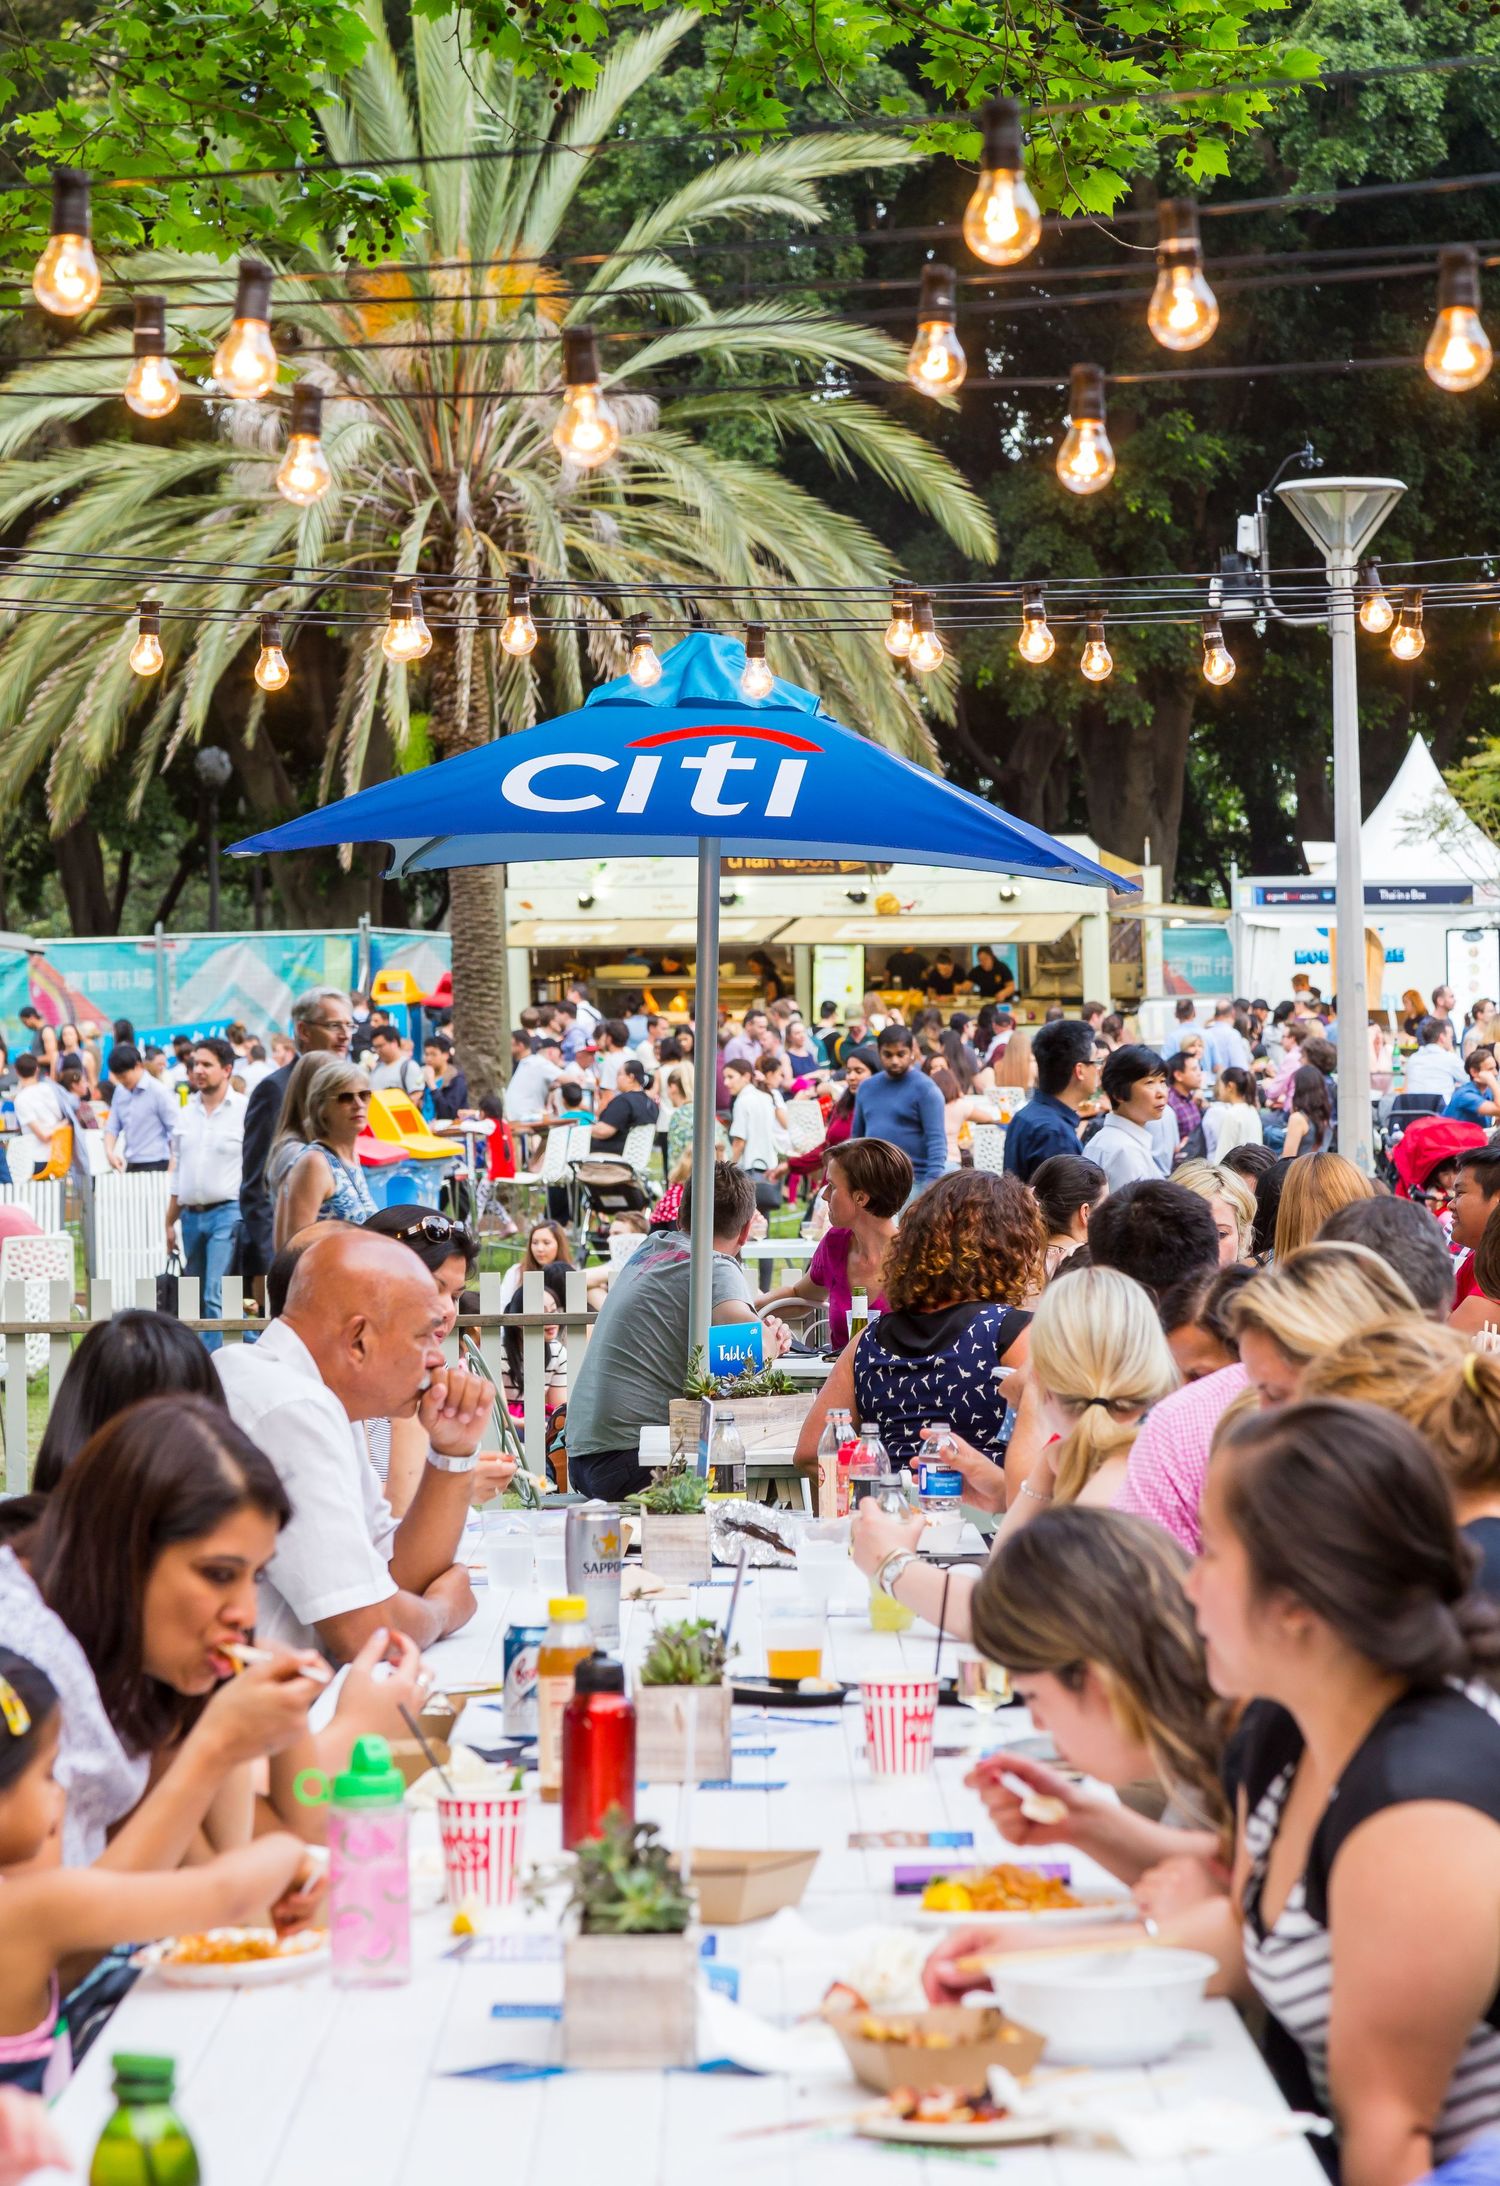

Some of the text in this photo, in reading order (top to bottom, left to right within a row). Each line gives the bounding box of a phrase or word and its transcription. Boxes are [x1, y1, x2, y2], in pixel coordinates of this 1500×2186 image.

[501, 741, 808, 817] citi
[717, 1343, 753, 1361] Table 6
